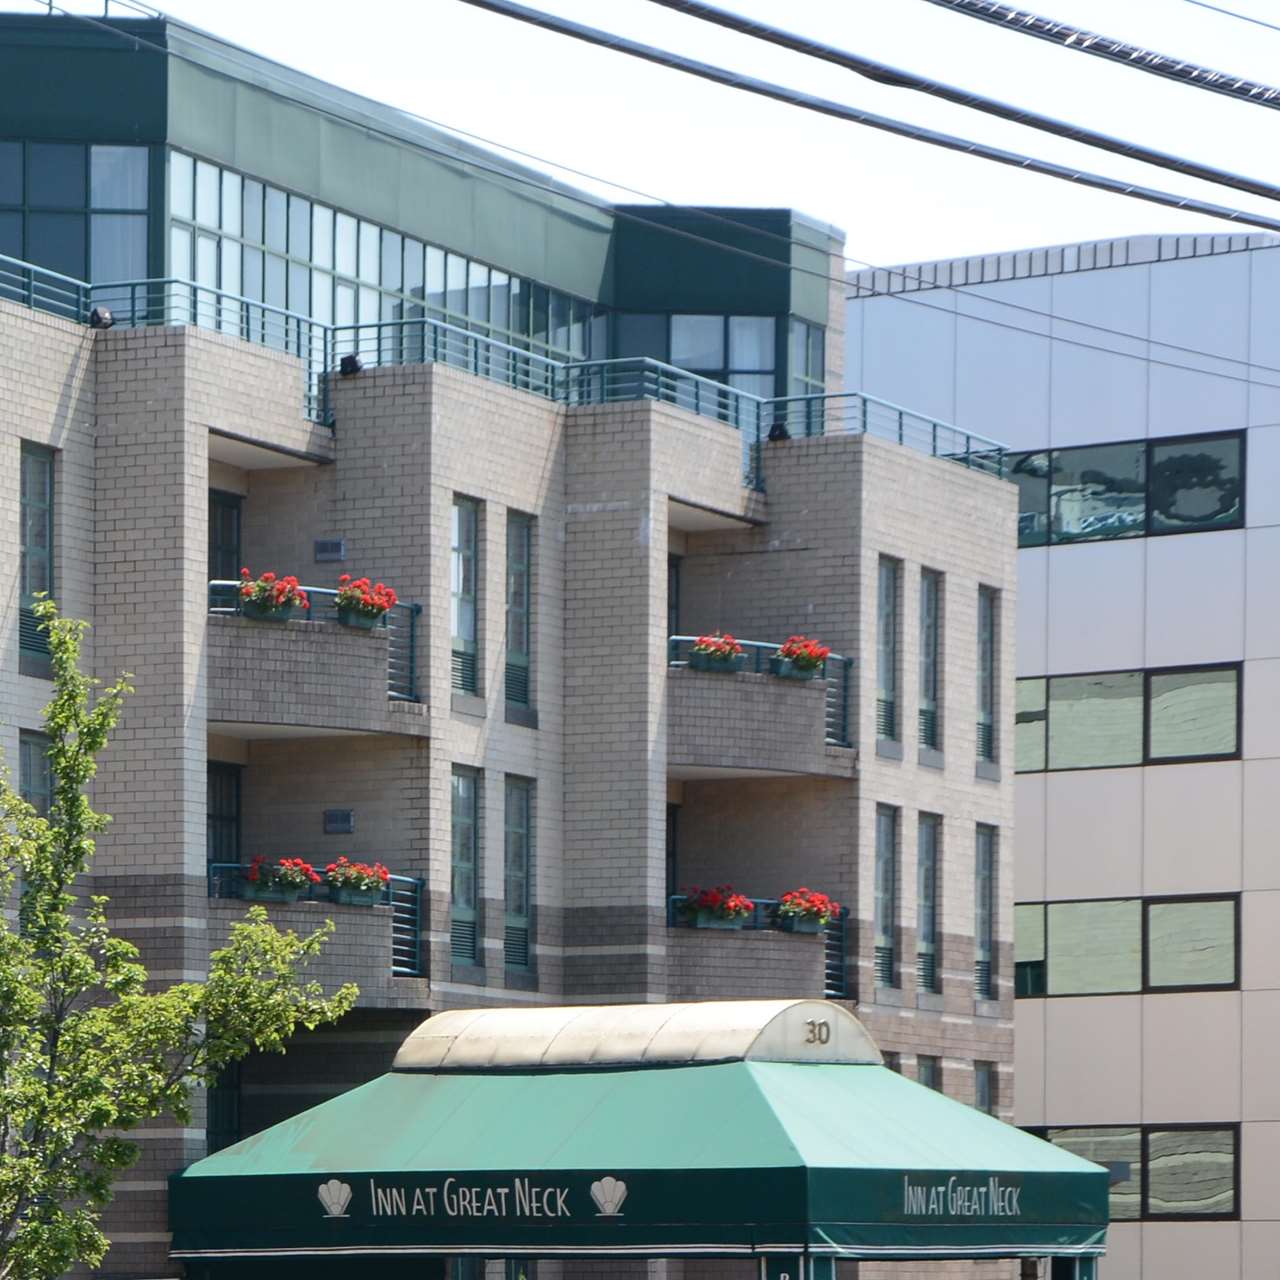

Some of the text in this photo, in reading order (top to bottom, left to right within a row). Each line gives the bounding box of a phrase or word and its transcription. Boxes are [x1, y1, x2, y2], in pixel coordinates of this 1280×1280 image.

[805, 1020, 831, 1045] 30
[369, 1177, 571, 1217] INN AT GREAT NECK
[904, 1175, 1021, 1216] INN AT GREAT NECK
